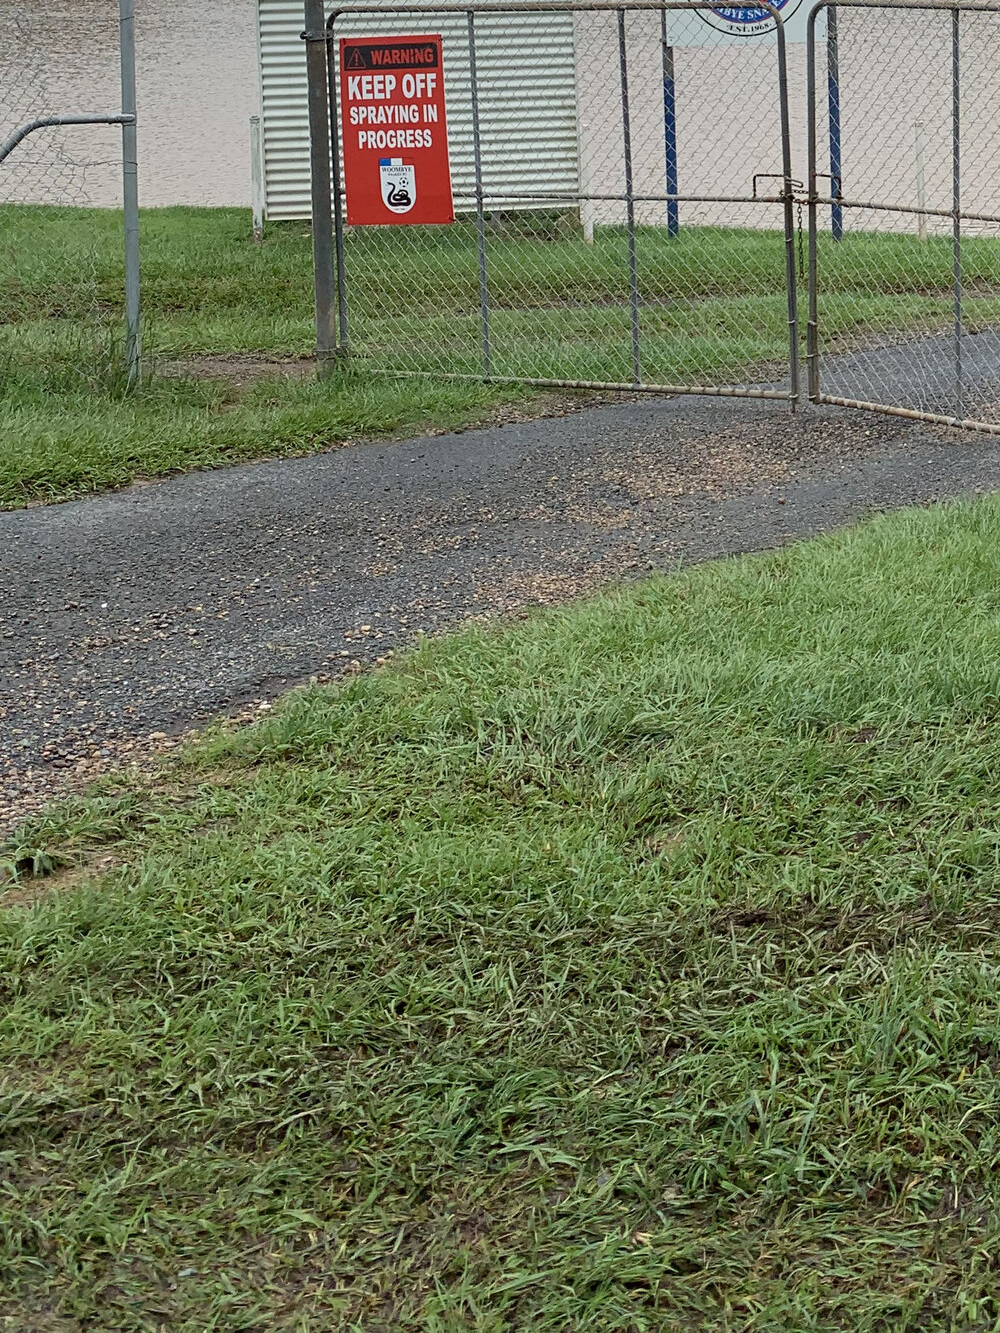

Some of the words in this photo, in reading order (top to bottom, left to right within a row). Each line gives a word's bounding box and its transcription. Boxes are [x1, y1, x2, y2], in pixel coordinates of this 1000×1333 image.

[370, 48, 434, 65] WARNING
[347, 74, 397, 100] KEEP
[402, 72, 437, 99] OFF
[349, 105, 420, 125] SPRAYING
[423, 104, 438, 123] IN
[358, 128, 433, 149] PROGRESS
